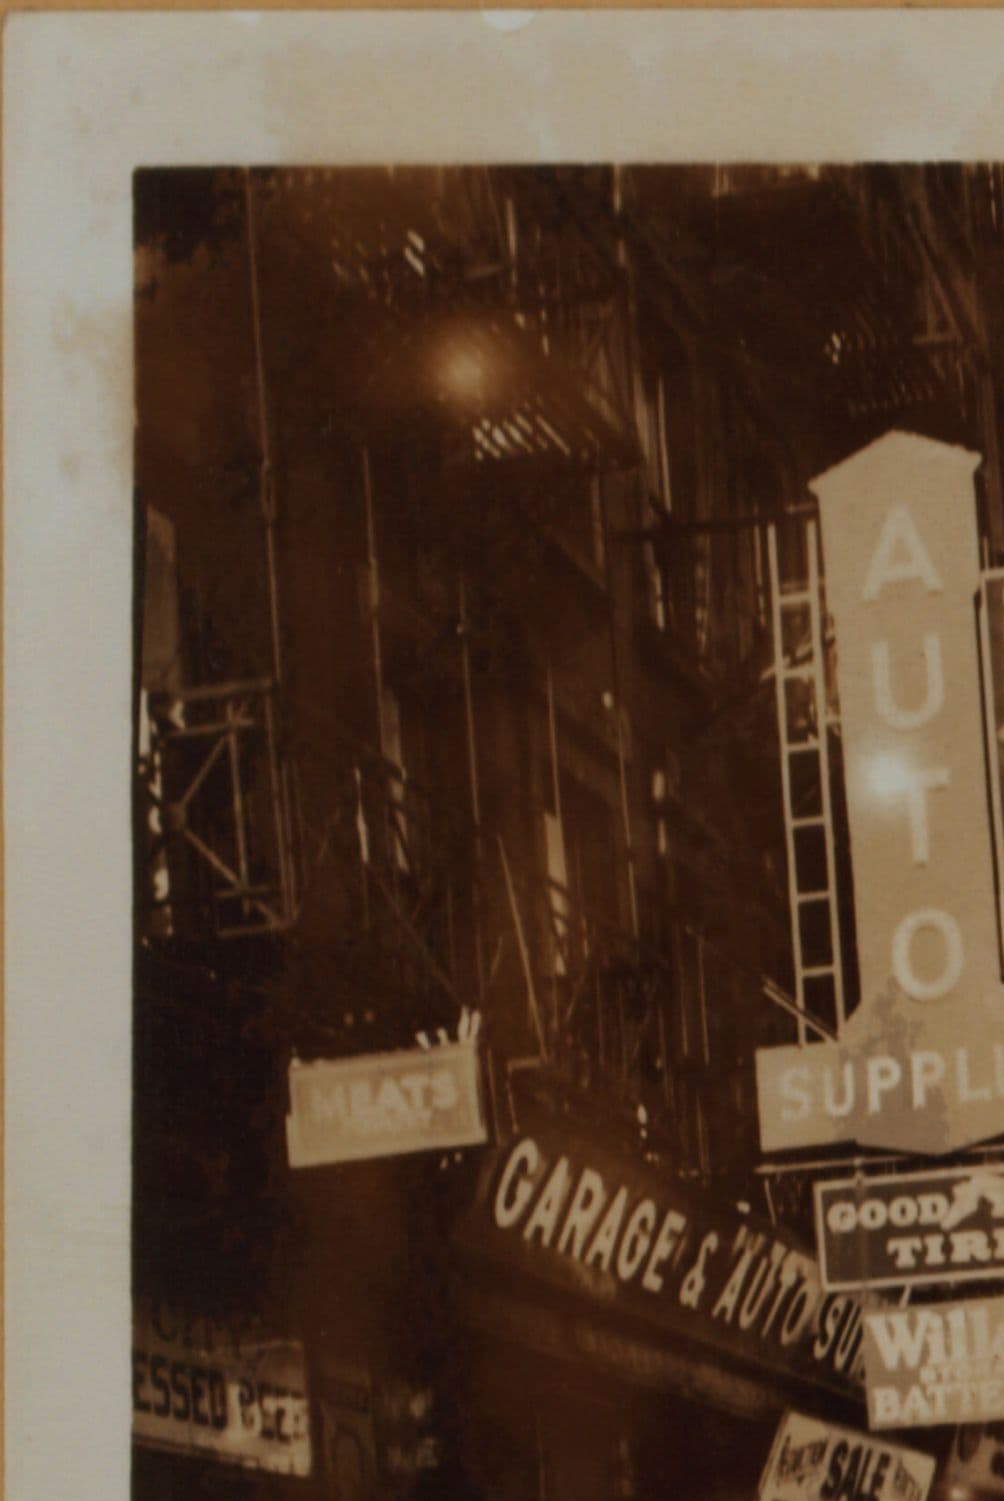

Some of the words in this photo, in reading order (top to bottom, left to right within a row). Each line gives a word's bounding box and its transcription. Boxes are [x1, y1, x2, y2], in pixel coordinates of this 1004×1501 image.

[865, 505, 963, 1000] AUTO
[310, 1070, 458, 1124] MEATS
[494, 1136, 687, 1293] GARAGE
[678, 1229, 719, 1311] &
[711, 1238, 818, 1347] AUTO
